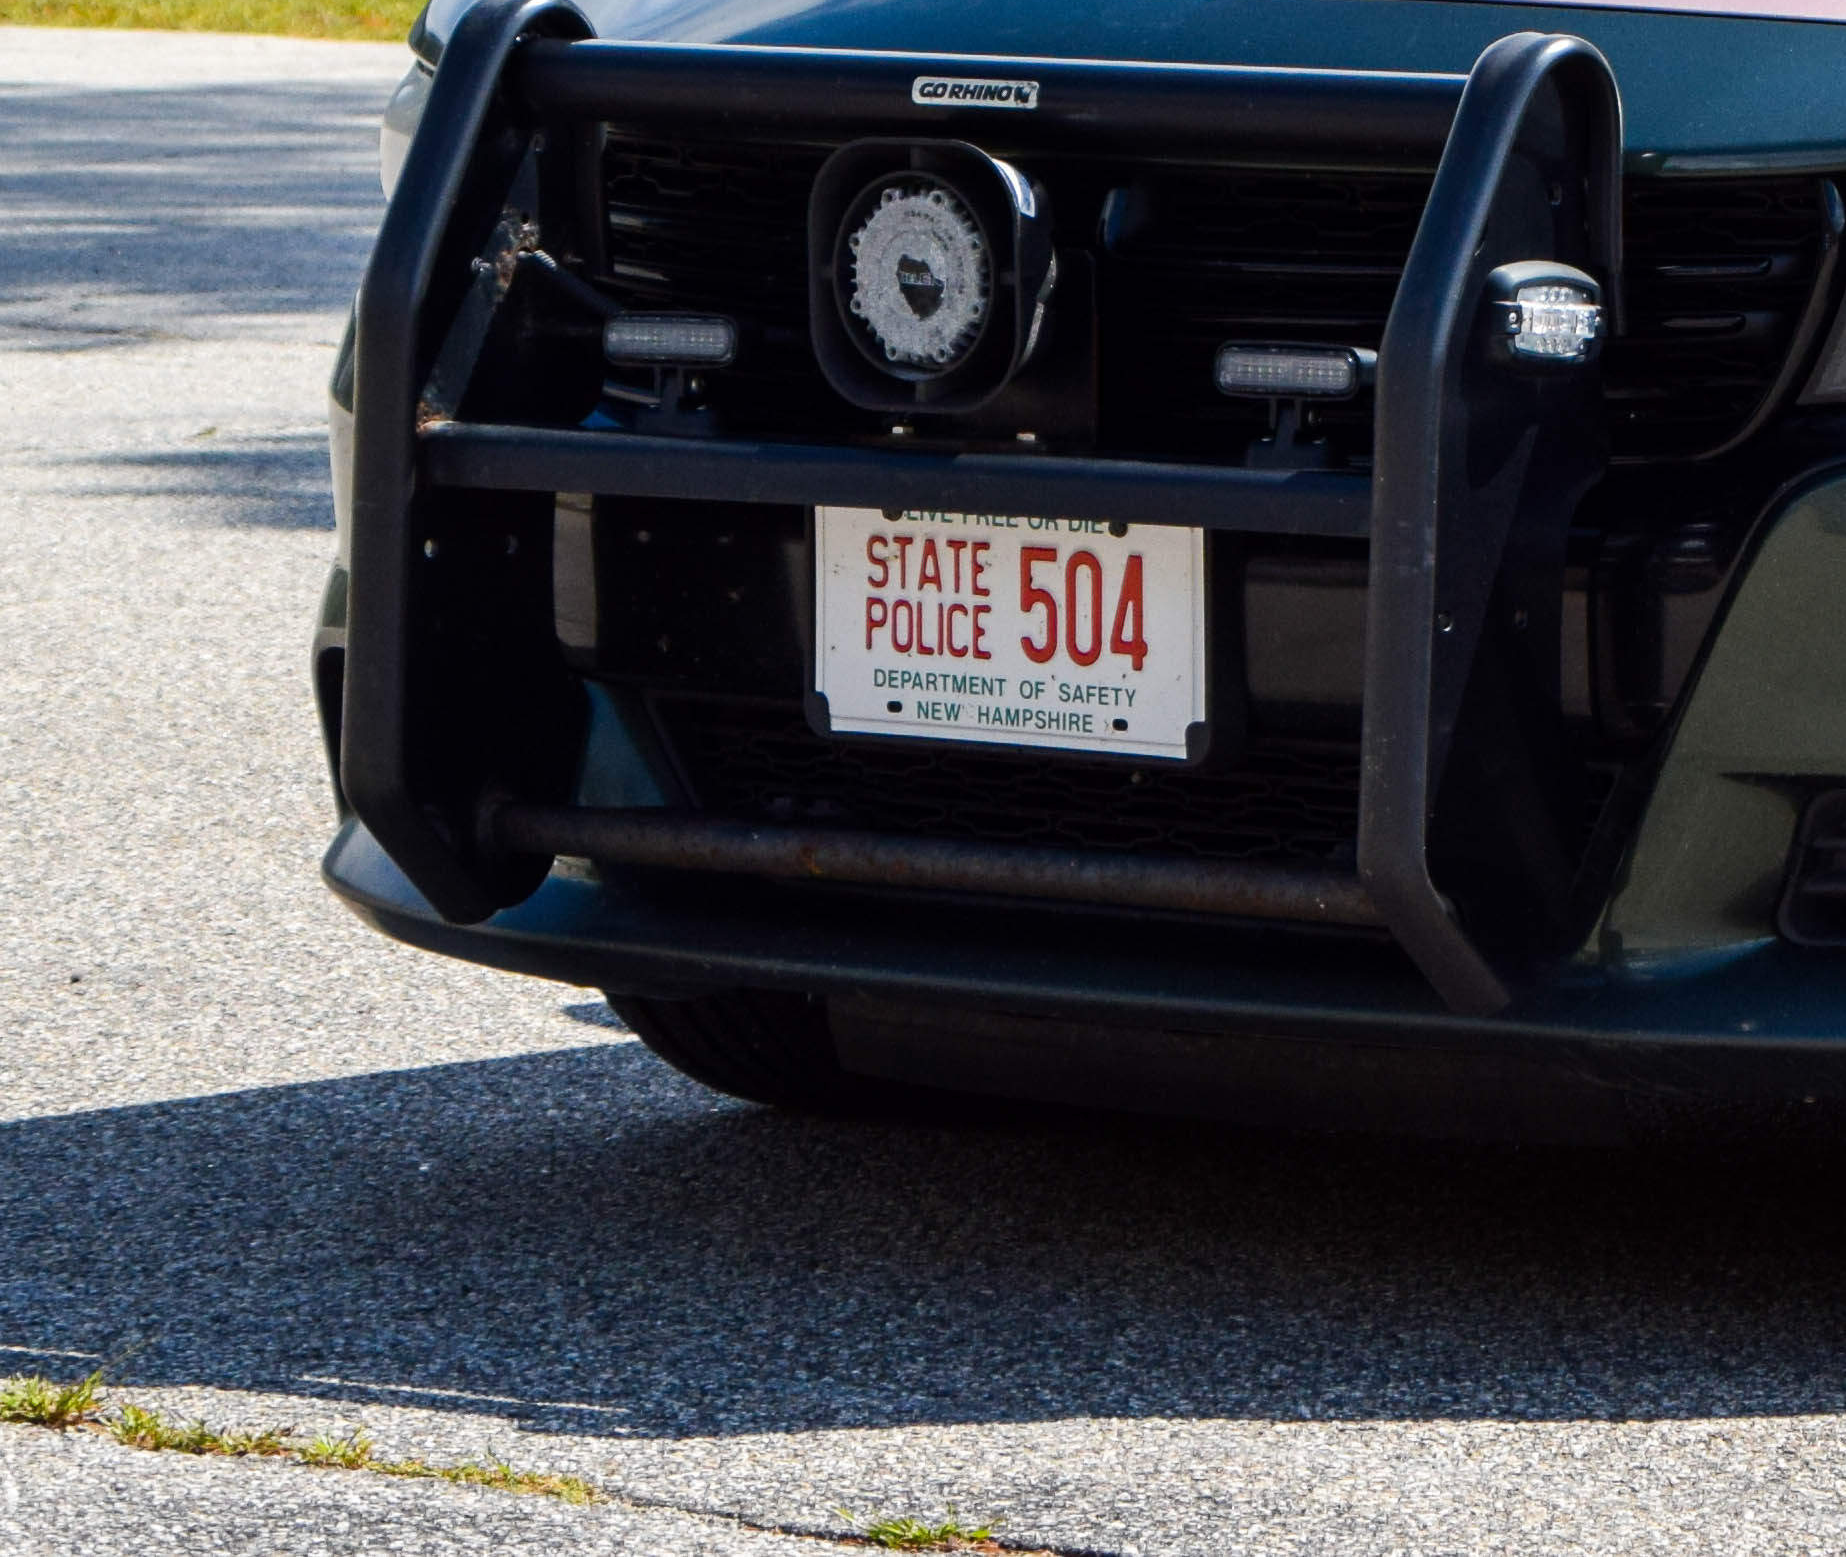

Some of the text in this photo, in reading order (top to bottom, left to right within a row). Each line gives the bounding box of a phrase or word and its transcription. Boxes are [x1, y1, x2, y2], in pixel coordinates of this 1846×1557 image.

[866, 535, 992, 597] STATE
[865, 596, 992, 660] POLICE
[1020, 546, 1149, 671] 504
[873, 668, 1136, 708] DEPARTMENT OF SAFETY
[917, 700, 1094, 733] NEW HAMPSHIRE
